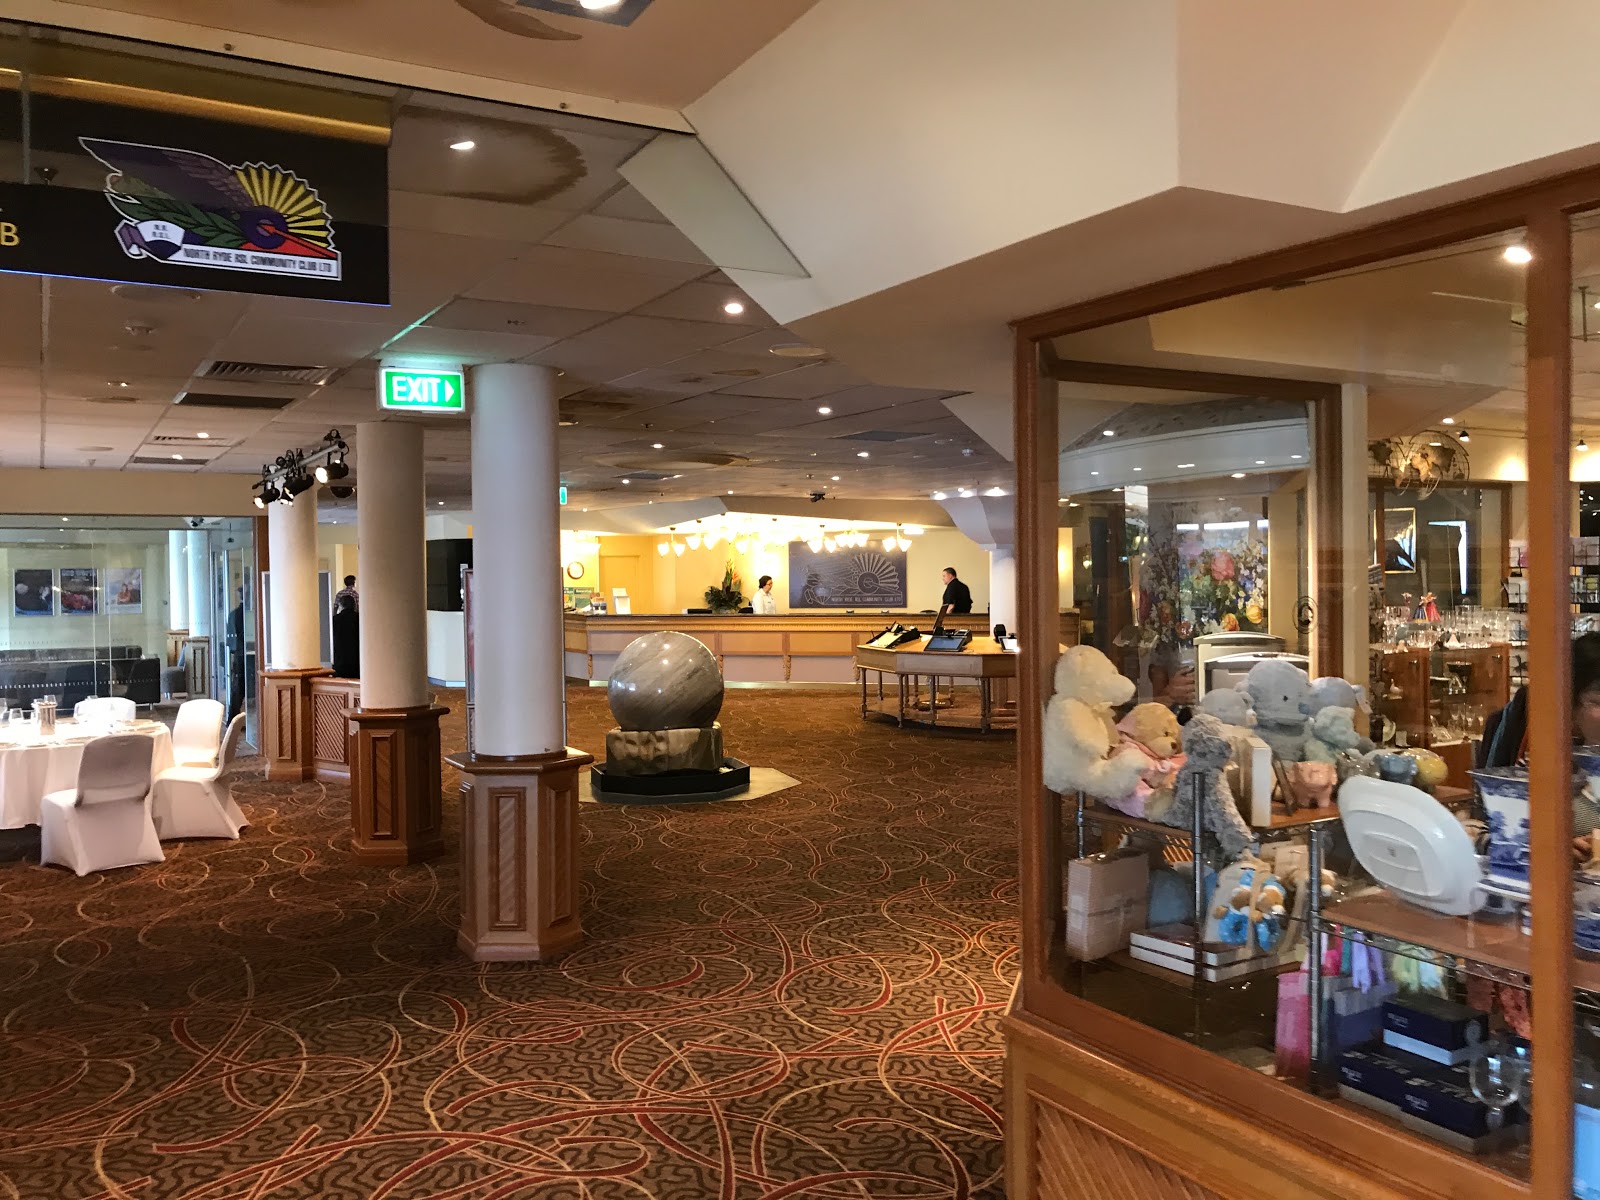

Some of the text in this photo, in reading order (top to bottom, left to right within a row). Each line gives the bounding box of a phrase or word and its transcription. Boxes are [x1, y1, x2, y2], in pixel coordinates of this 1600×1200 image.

[183, 247, 332, 273] NORTH RYDE RSL COMMUNITY CLUB LTD
[392, 376, 441, 403] EXIT
